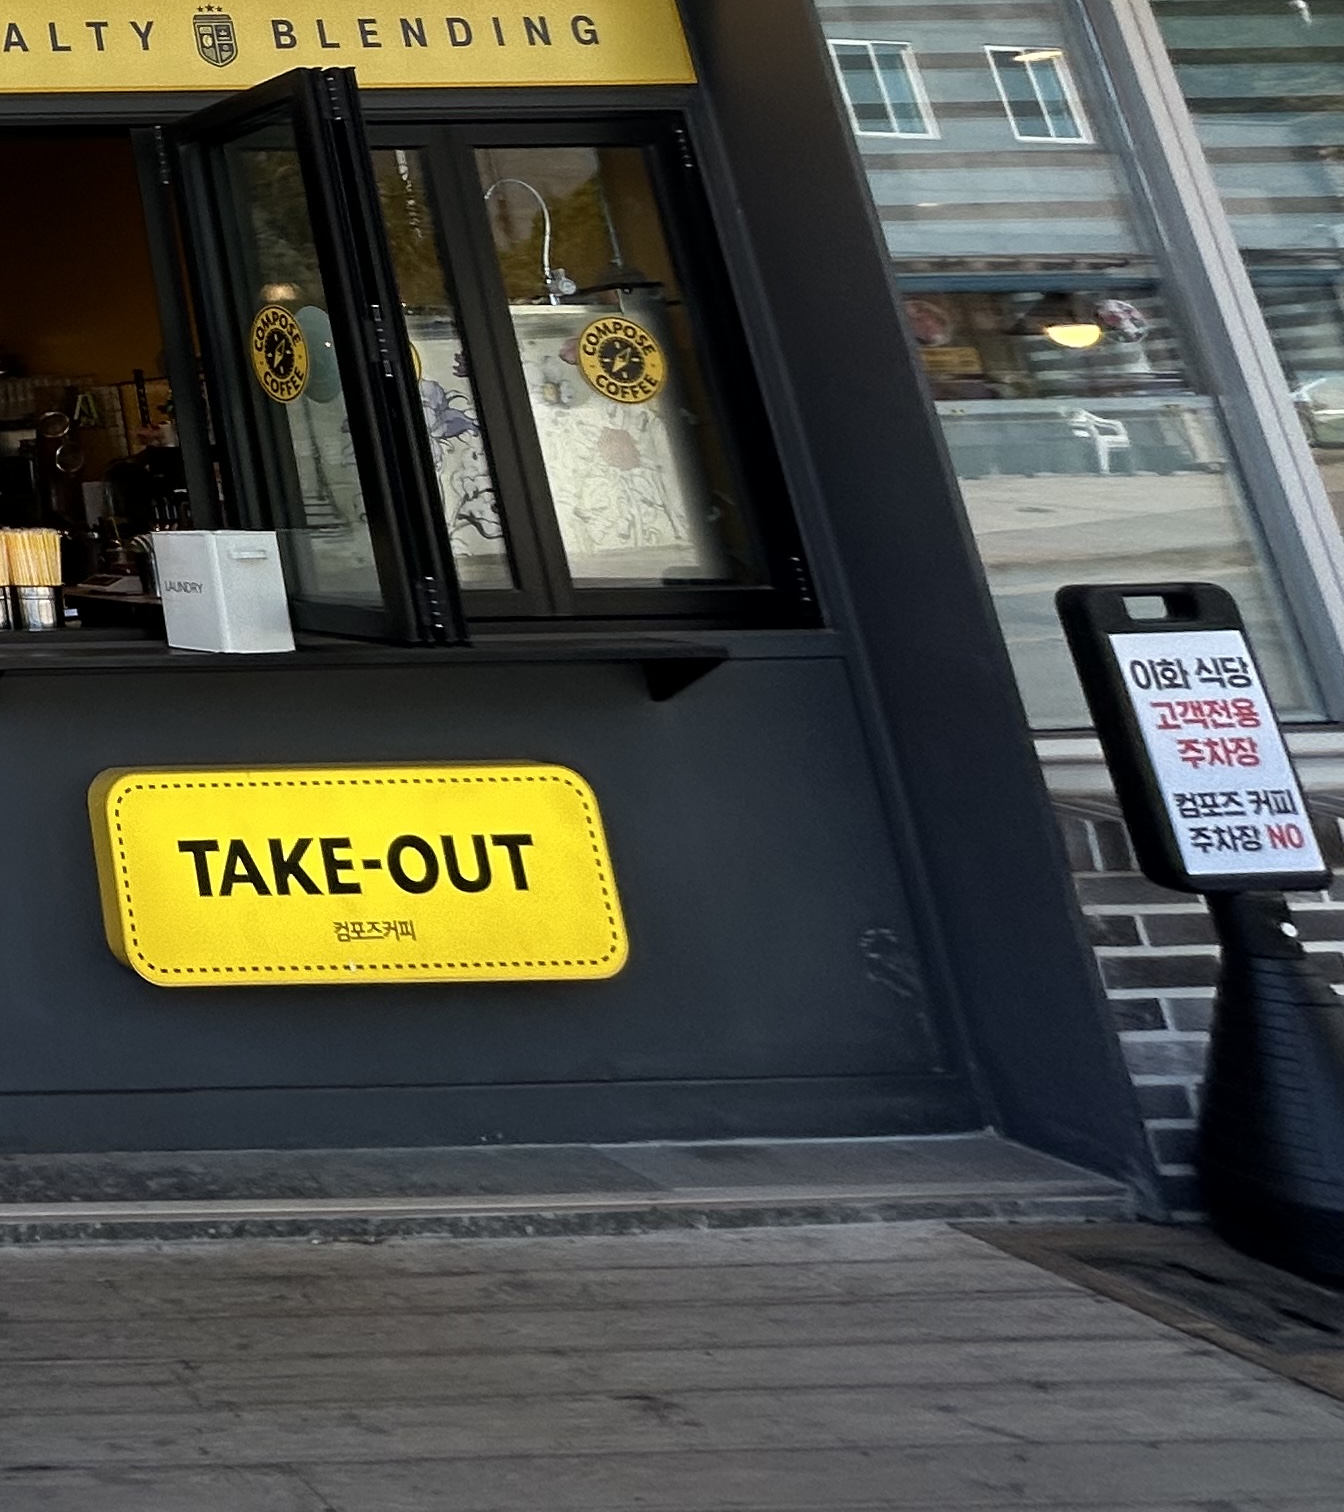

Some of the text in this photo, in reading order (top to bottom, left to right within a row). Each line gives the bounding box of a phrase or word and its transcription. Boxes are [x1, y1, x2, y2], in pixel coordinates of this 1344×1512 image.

[270, 14, 605, 51] BLENDING
[254, 310, 302, 352] COMPOSE
[582, 321, 656, 356] COMPOSE
[263, 366, 304, 397] COFFEE
[595, 374, 659, 399] COFFEE
[1130, 656, 1253, 692] 이화 식당
[1150, 697, 1261, 730] 고객전용
[1177, 736, 1261, 769] 주차장
[1174, 789, 1300, 819] 컴포즈 커피
[1189, 823, 1305, 853] 주차장 NO
[177, 833, 534, 897] TAKE-OUT
[333, 919, 417, 942] 컴포즈커피
